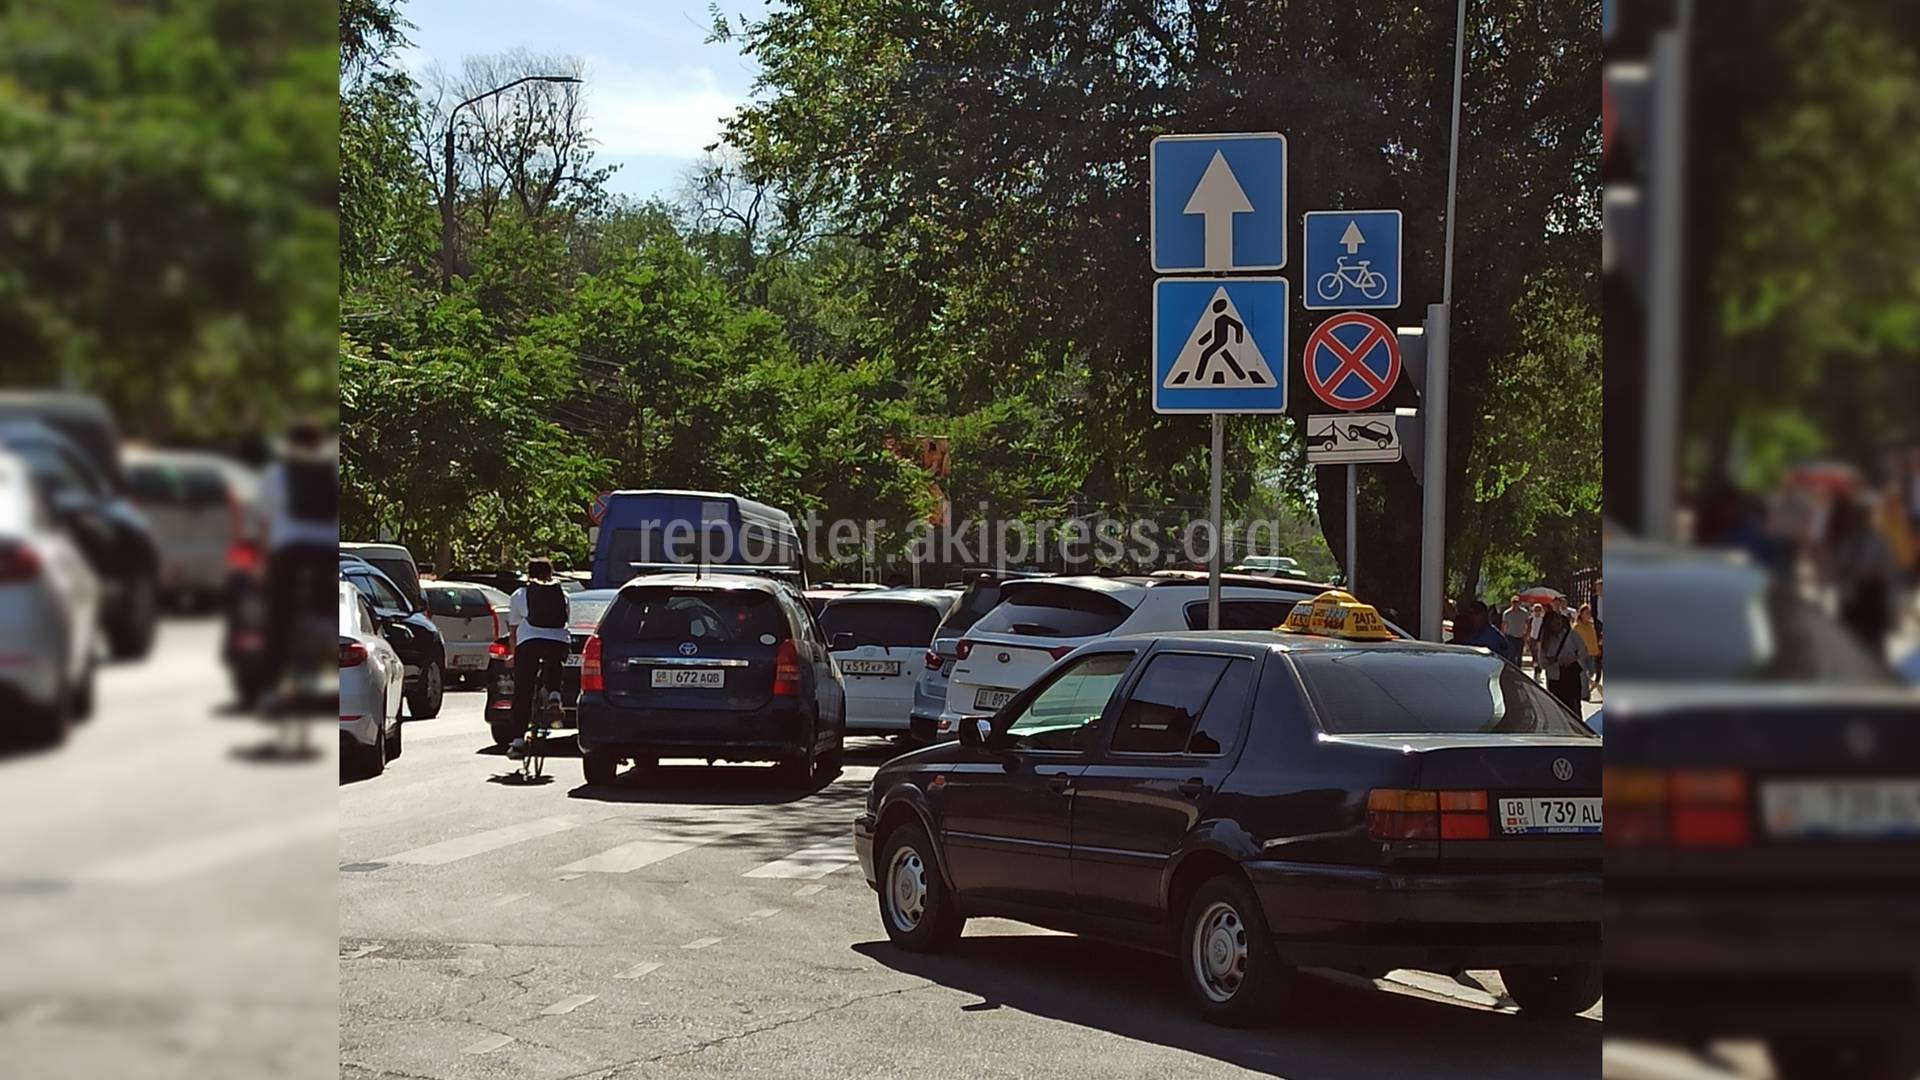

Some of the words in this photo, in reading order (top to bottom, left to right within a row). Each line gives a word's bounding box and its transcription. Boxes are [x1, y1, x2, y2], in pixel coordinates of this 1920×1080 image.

[676, 671, 698, 683] 672
[1507, 801, 1525, 816] 08
[1540, 801, 1577, 824] 739
[1582, 804, 1602, 823] AL
